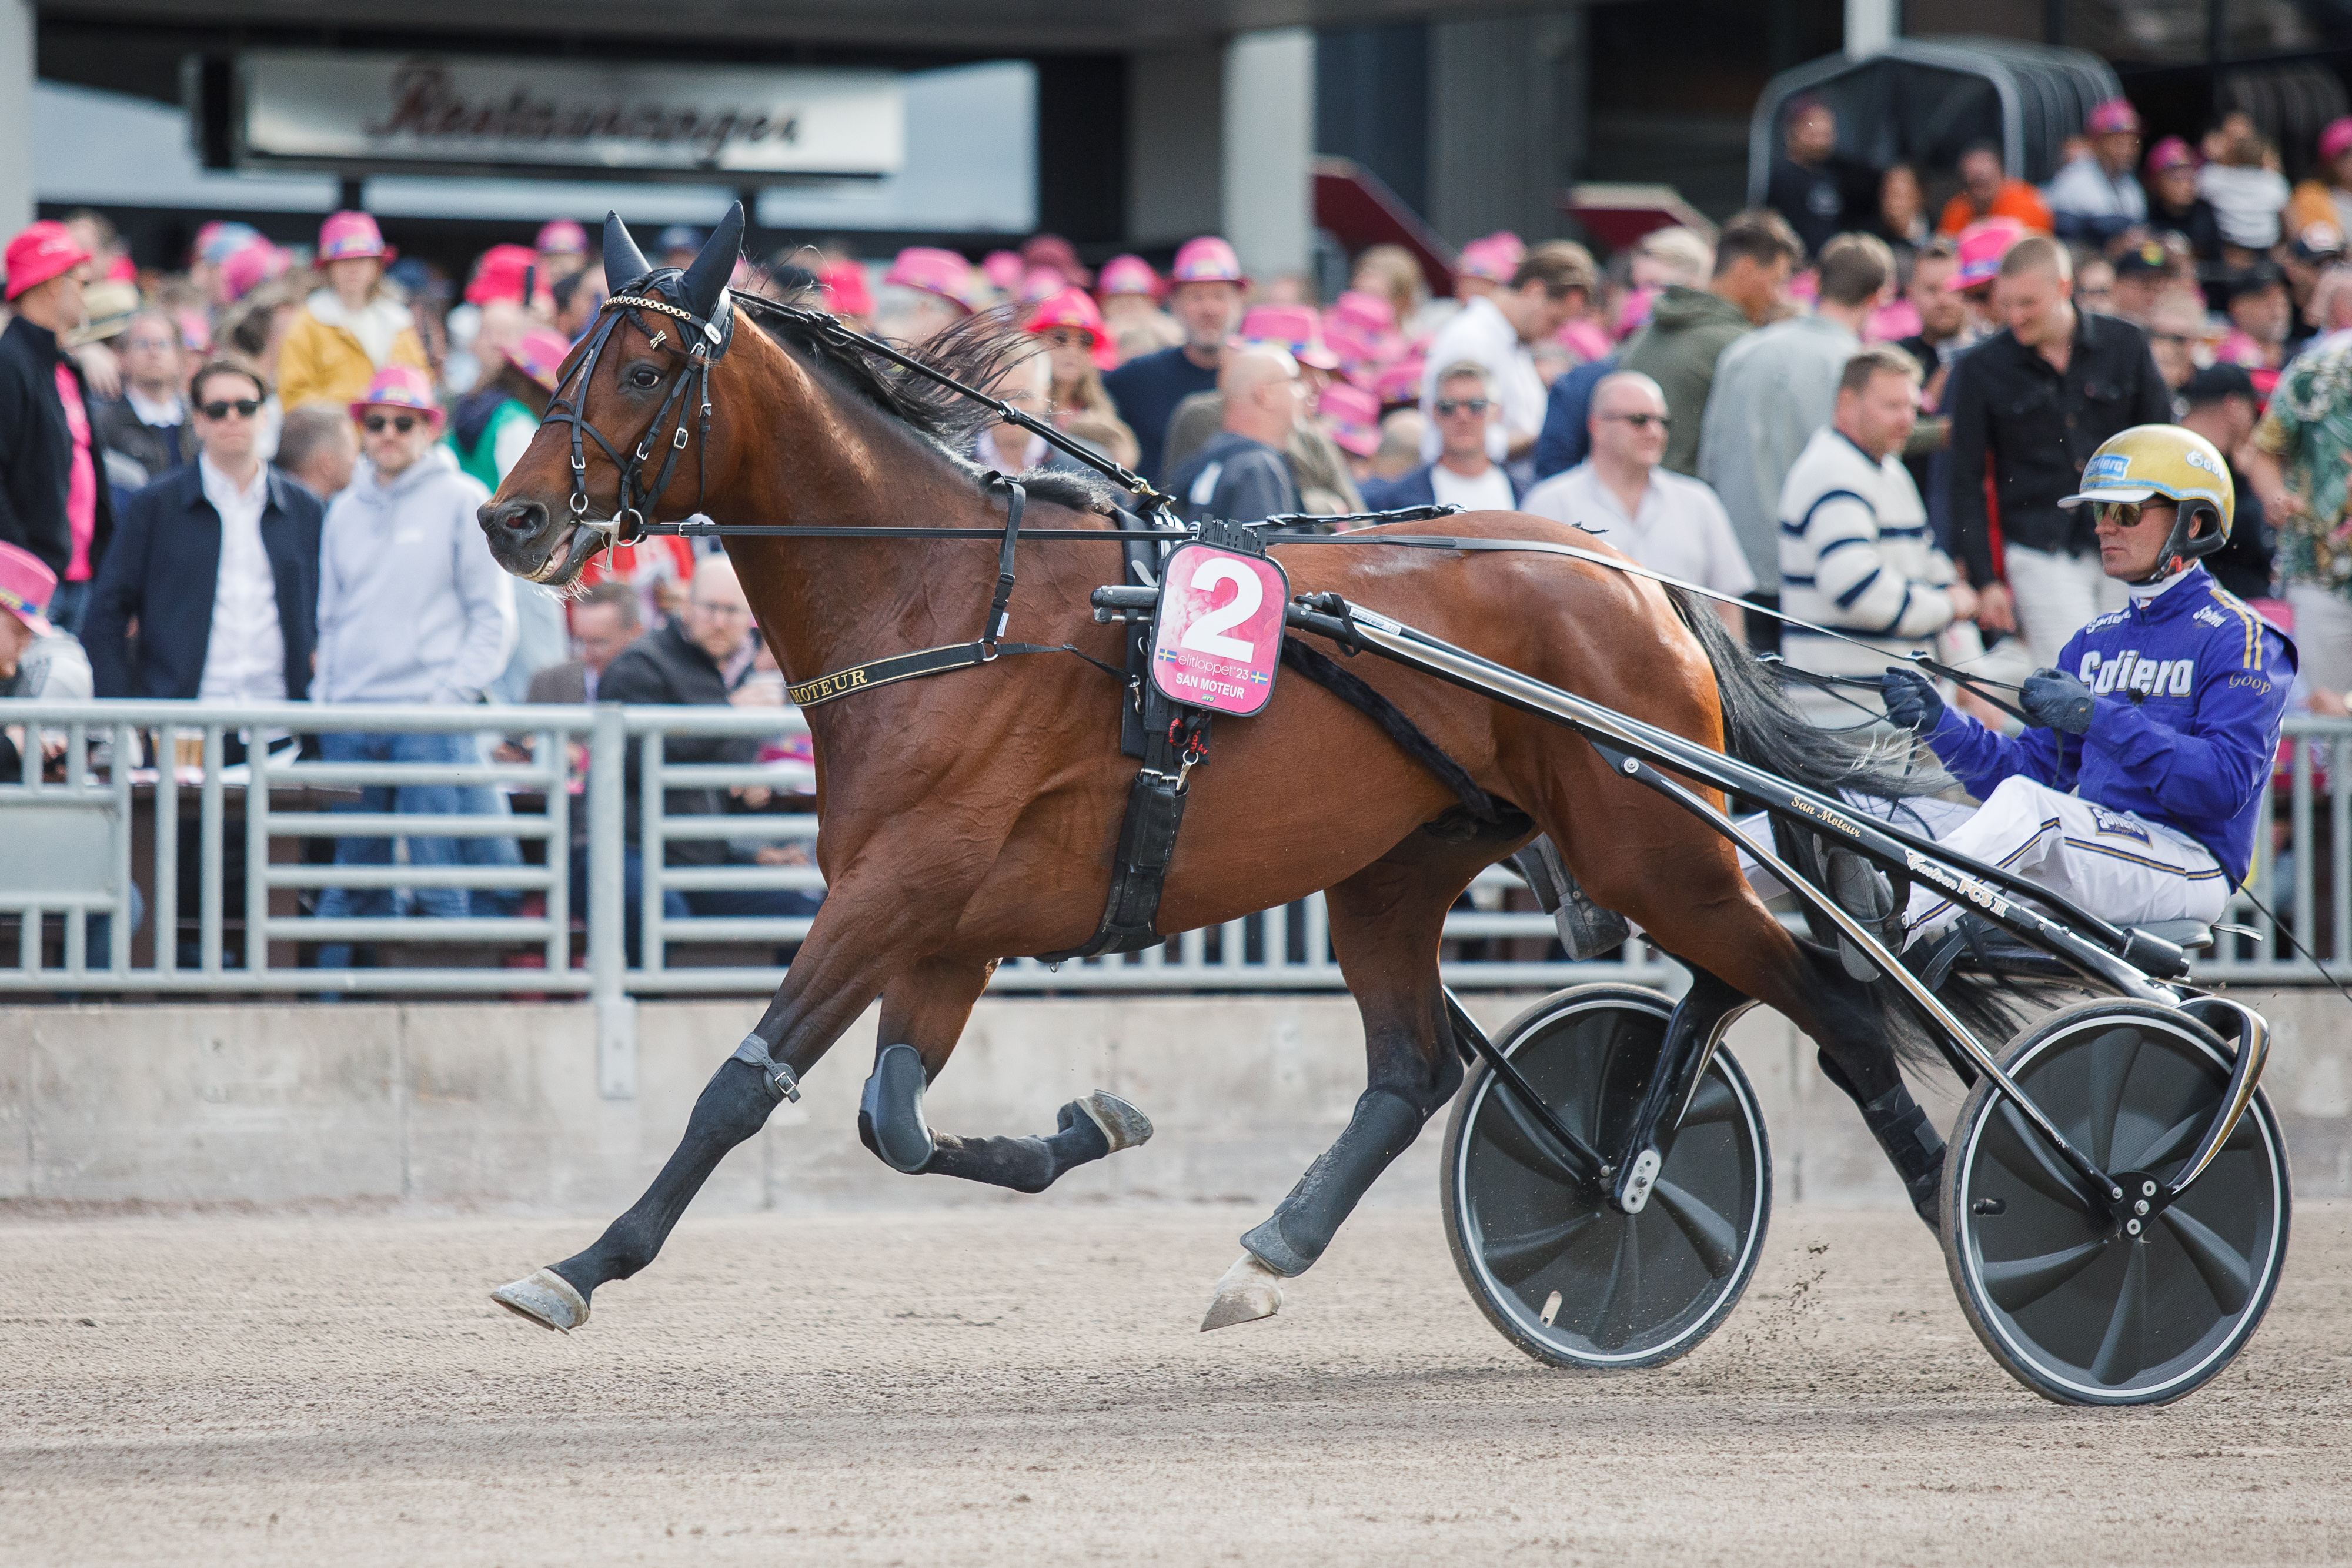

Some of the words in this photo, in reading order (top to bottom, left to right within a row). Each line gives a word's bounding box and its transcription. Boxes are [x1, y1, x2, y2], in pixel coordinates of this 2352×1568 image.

[1180, 557, 1264, 664] 2
[1388, 626, 1399, 634] 170
[790, 669, 868, 703] MOTEUR
[1175, 672, 1198, 688] SAN
[1200, 678, 1245, 700] MOTEUR
[2229, 671, 2271, 696] Goop
[1790, 796, 1815, 815] San
[1816, 810, 1861, 838] Moteur
[1957, 878, 1994, 908] FCS
